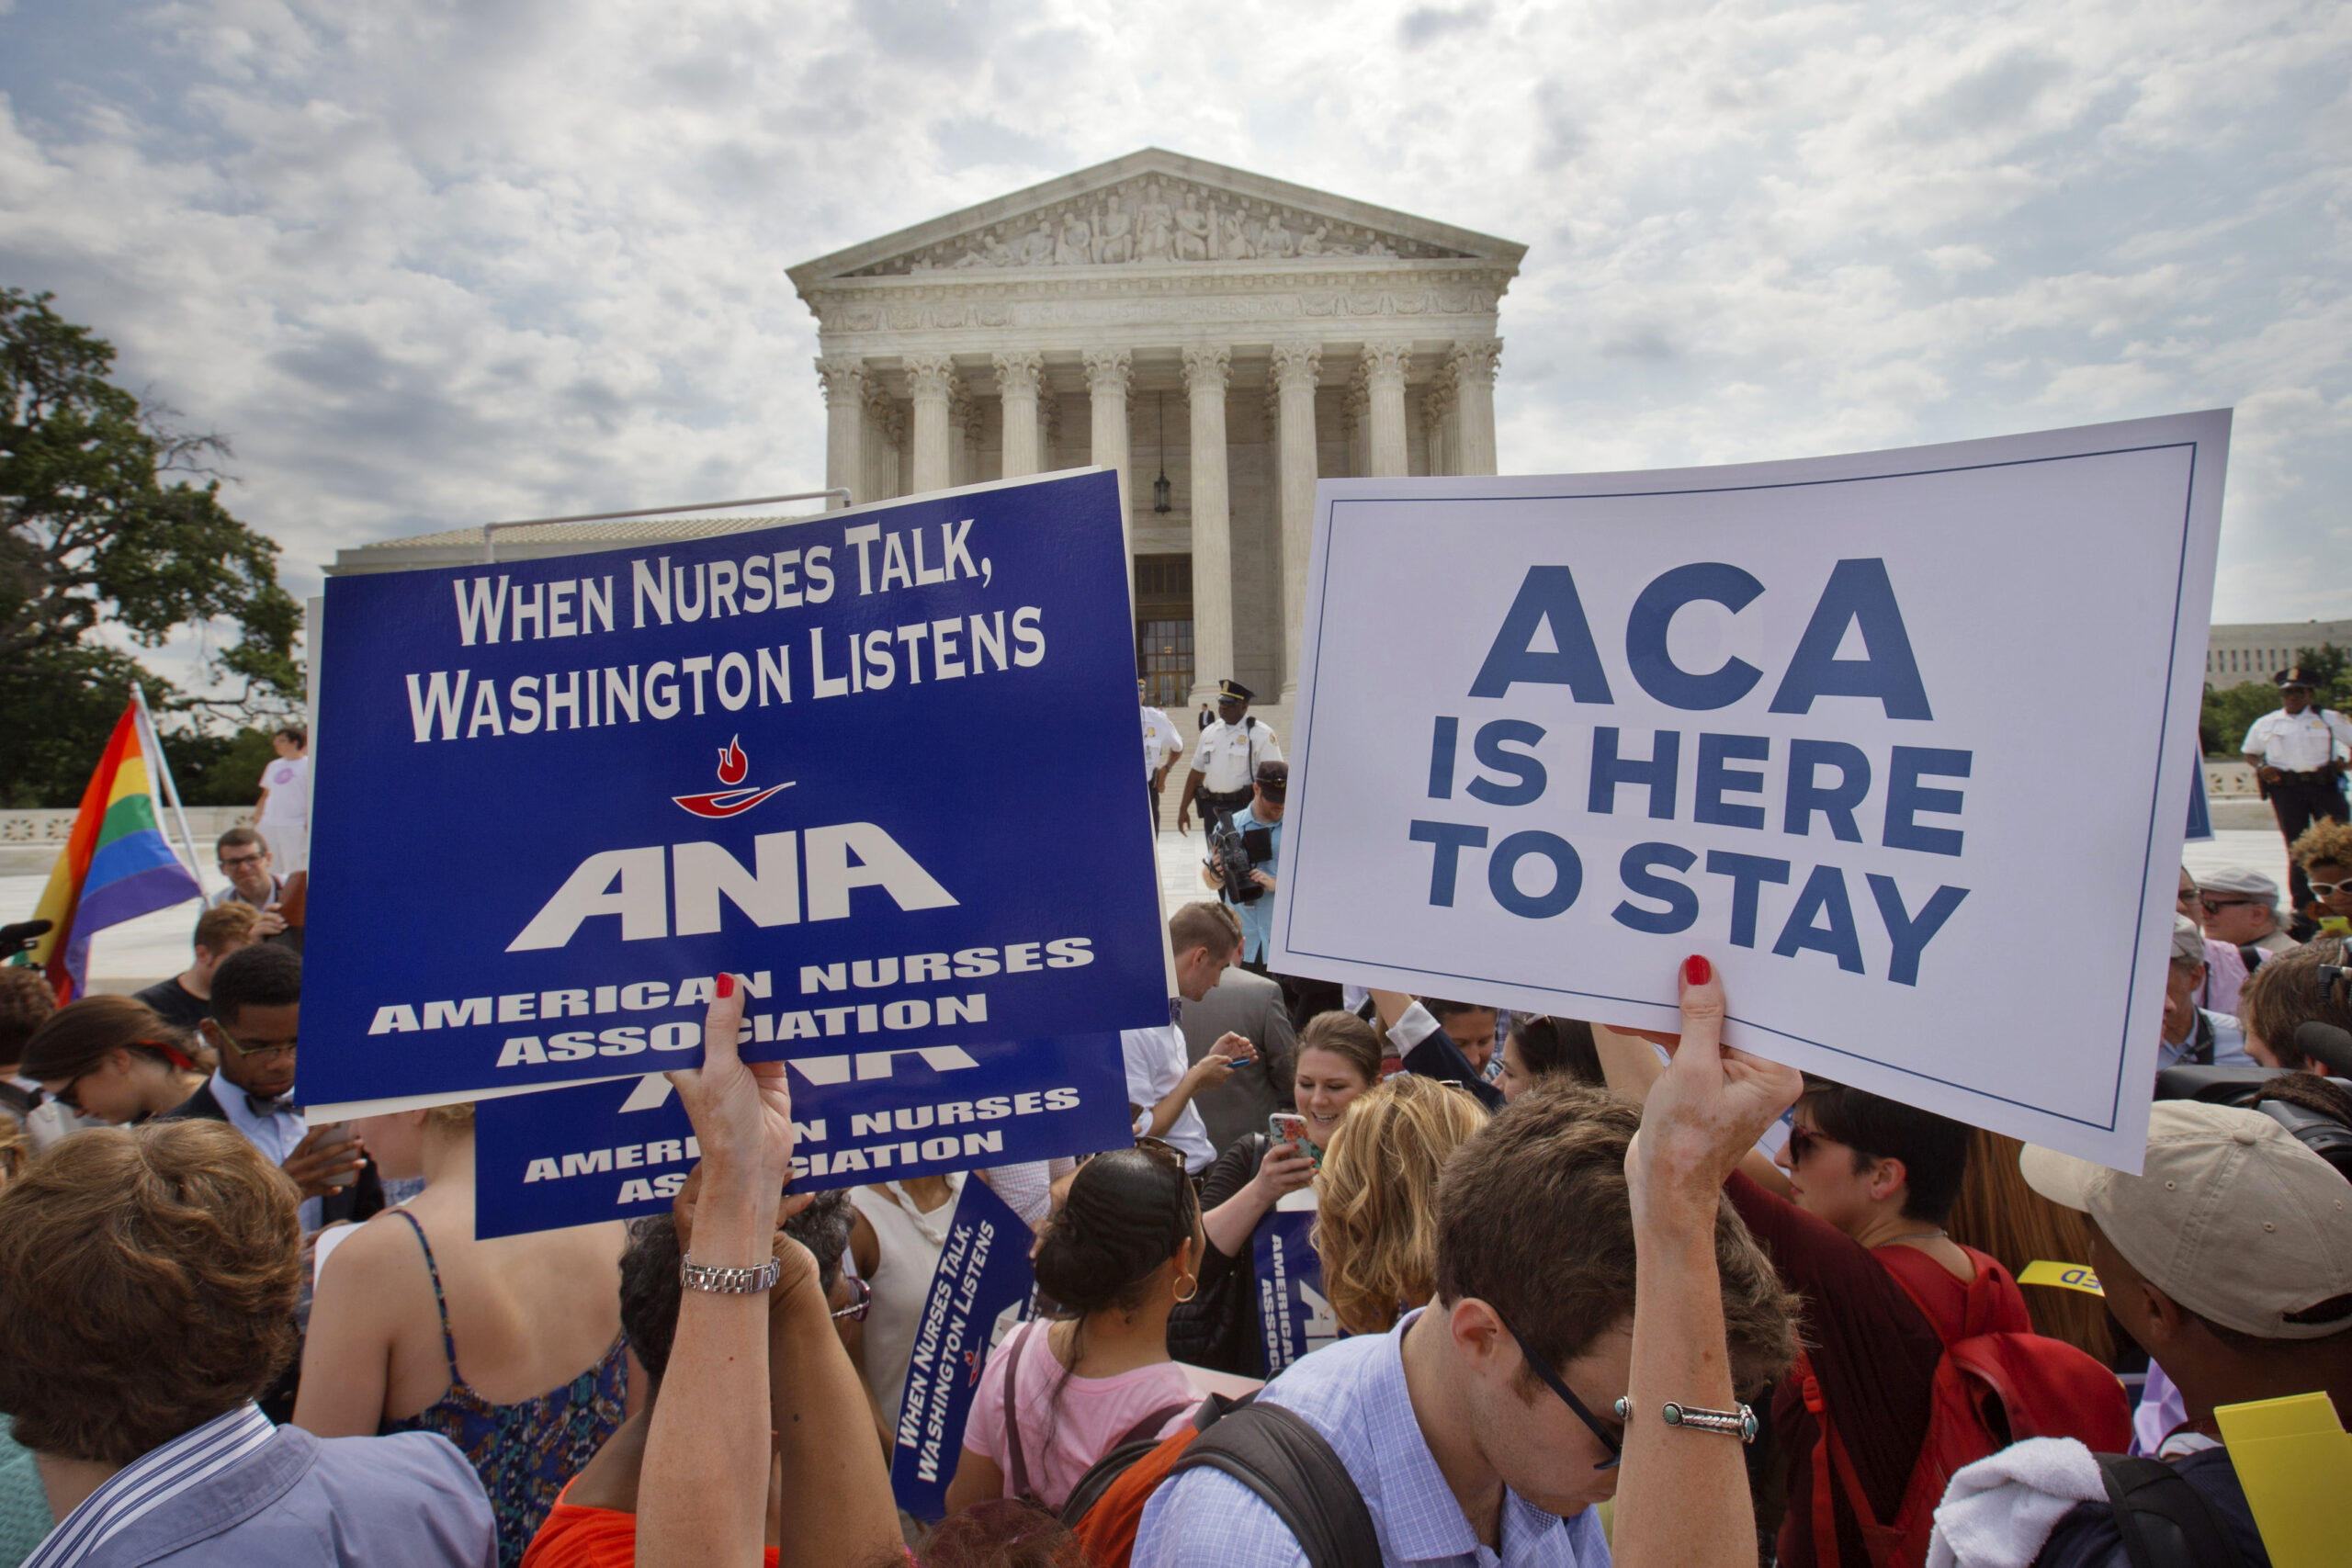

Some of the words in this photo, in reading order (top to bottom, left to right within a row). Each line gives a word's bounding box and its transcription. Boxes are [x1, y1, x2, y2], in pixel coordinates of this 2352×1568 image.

[453, 575, 614, 646] WHEN
[632, 546, 834, 628] NURSES
[845, 519, 992, 595] TALK,
[1468, 558, 1933, 720] ACA
[406, 645, 792, 742] WASHINGTON
[809, 606, 1045, 701] LISTENS
[1428, 717, 1545, 806] IS
[1588, 728, 1973, 856] HERE
[504, 822, 960, 952] ANA
[1409, 820, 1582, 919] TO
[1611, 843, 1970, 987] STAY
[800, 938, 1094, 994] NURSES
[524, 1118, 827, 1183] AMERIN
[851, 1088, 1080, 1136] NURSES
[617, 1137, 1003, 1204] ASIATION
[939, 1224, 974, 1279] TALK,
[913, 1280, 952, 1373] NURSES
[918, 1314, 966, 1483] WASHINGTON
[954, 1220, 994, 1315] LISTENS
[899, 1373, 928, 1449] WHEN
